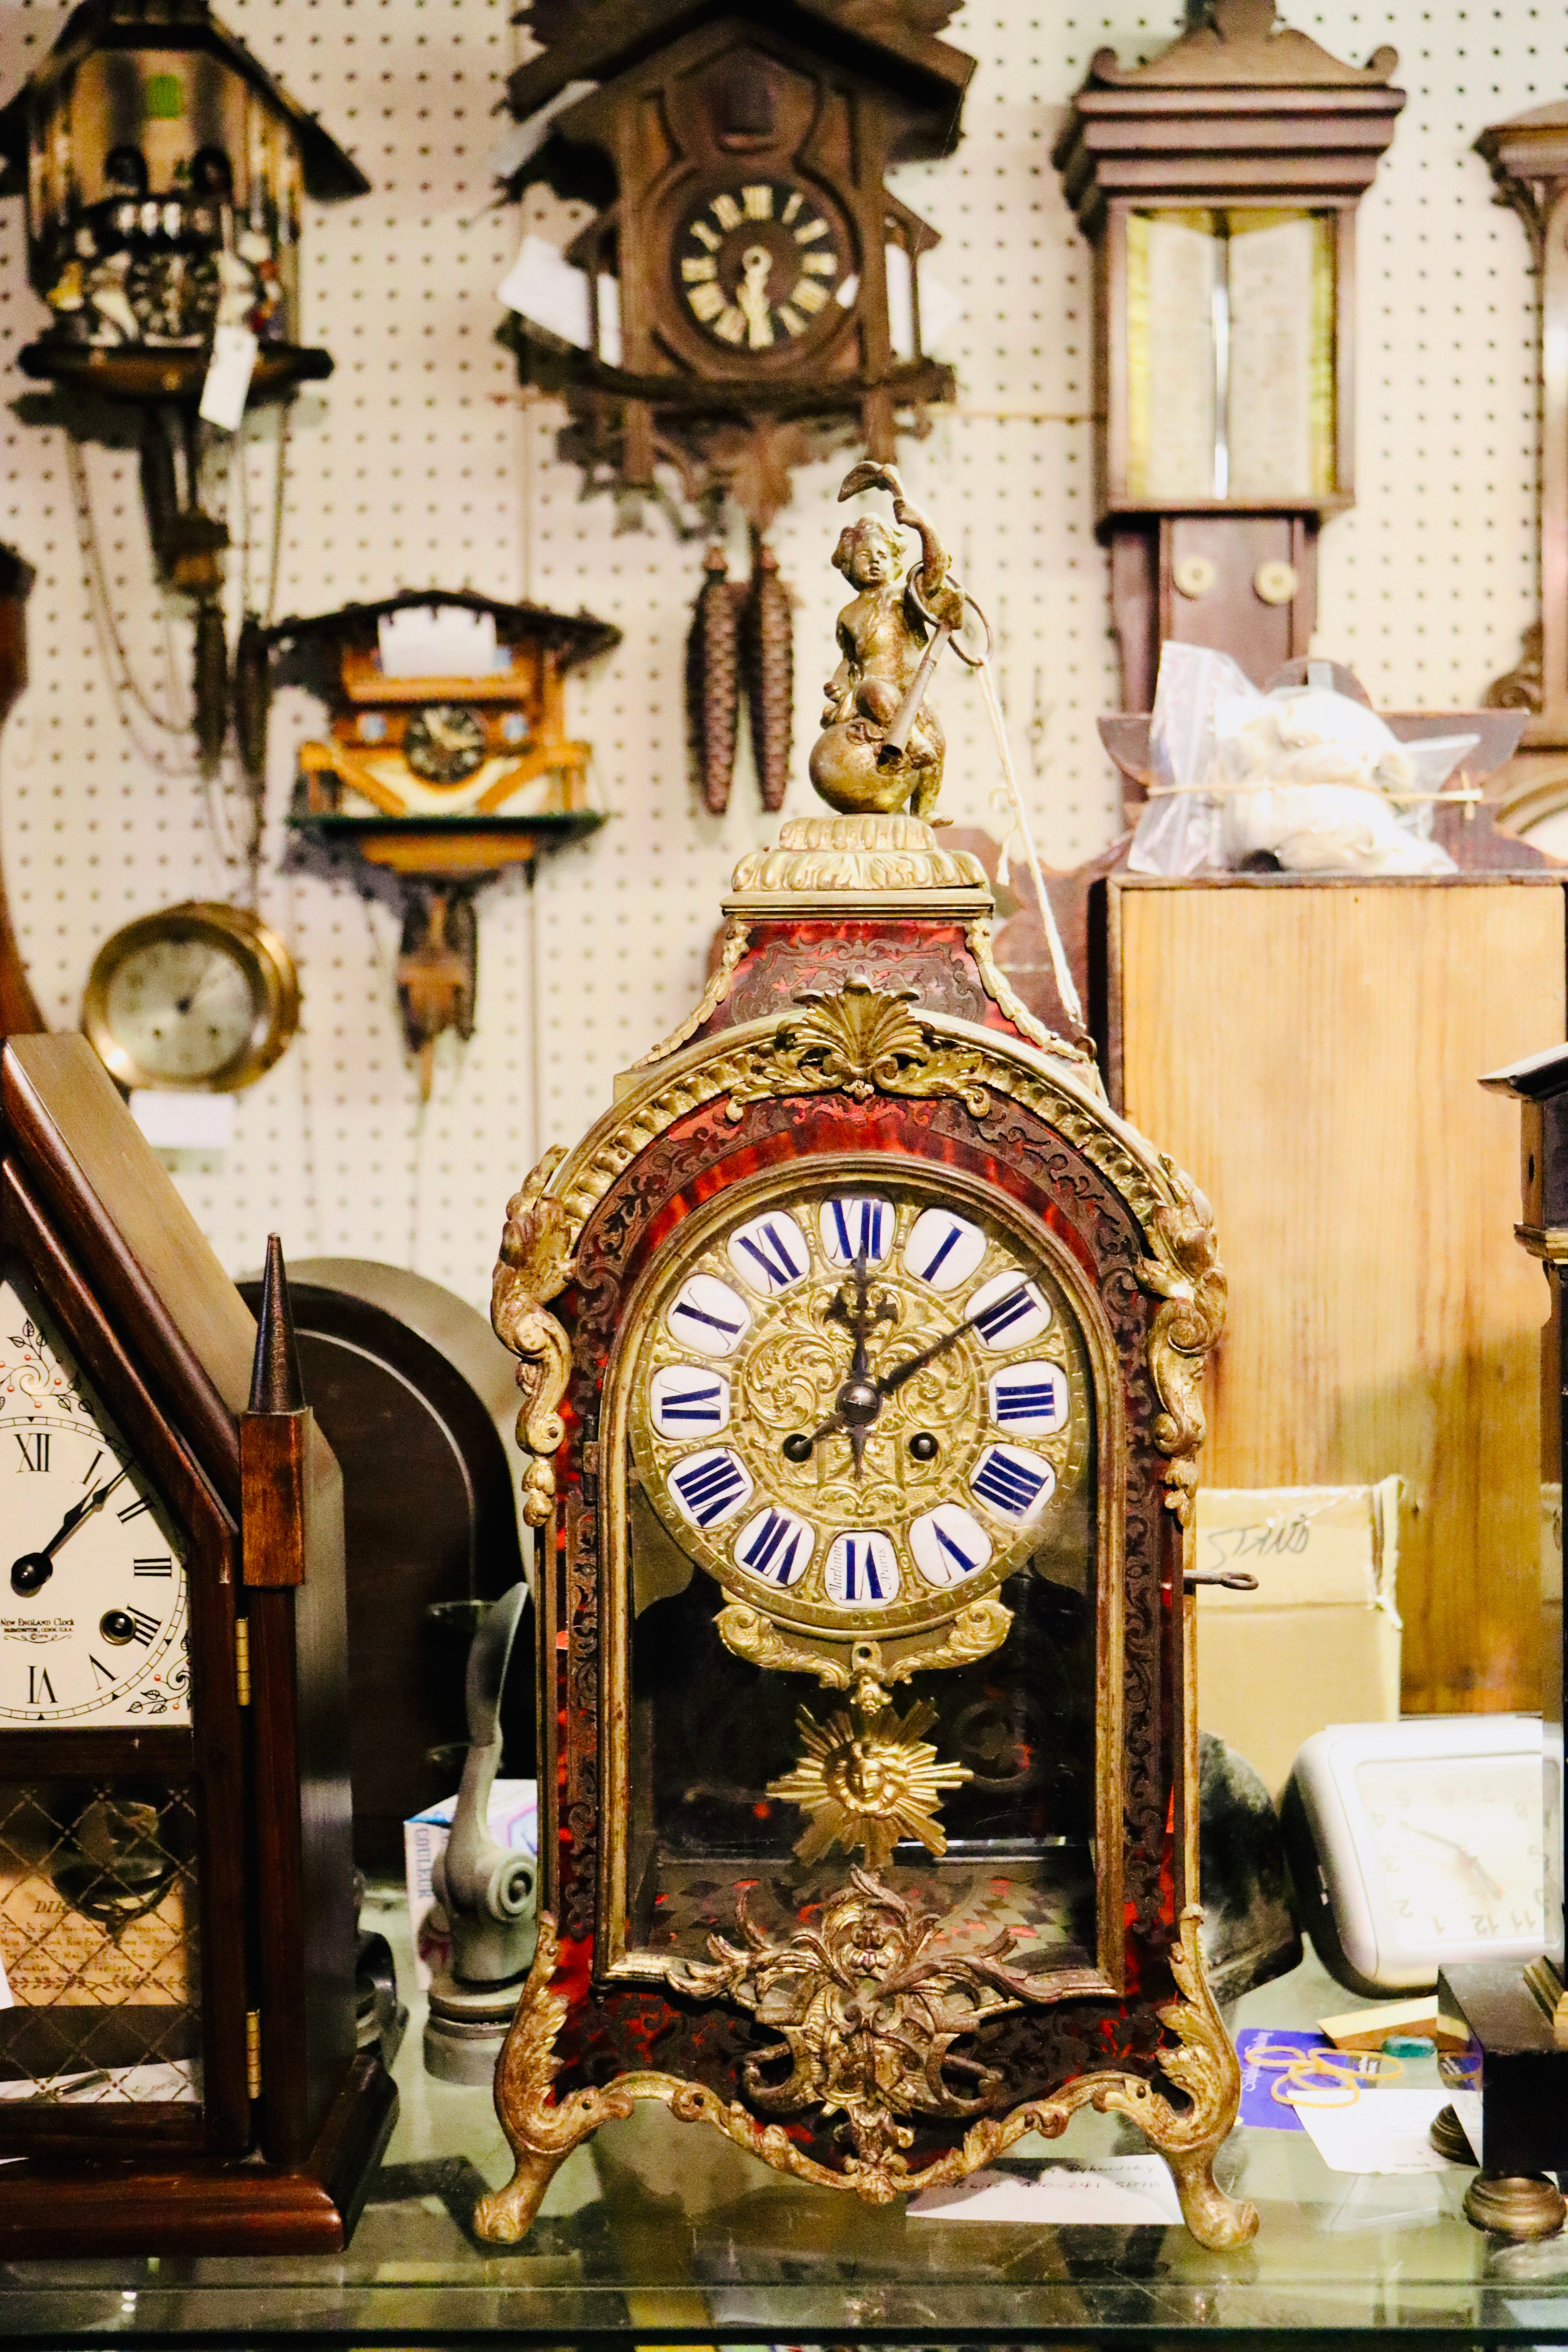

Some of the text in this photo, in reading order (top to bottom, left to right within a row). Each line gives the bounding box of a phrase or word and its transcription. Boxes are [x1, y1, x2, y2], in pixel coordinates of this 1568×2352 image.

[734, 1219, 805, 1294] XI
[672, 1287, 746, 1350] X
[971, 1281, 1042, 1346] II
[659, 1378, 721, 1426] IX
[995, 1377, 1057, 1424] III
[13, 1433, 53, 1473] XII
[971, 1446, 1049, 1517] IIII
[115, 1496, 154, 1526] II
[671, 1448, 749, 1528] VIII
[133, 1555, 172, 1579] III
[740, 1507, 804, 1586] VII
[840, 1538, 887, 1601] VI
[930, 1517, 981, 1584] V
[27, 1665, 58, 1704] VI
[88, 1653, 120, 1691] V
